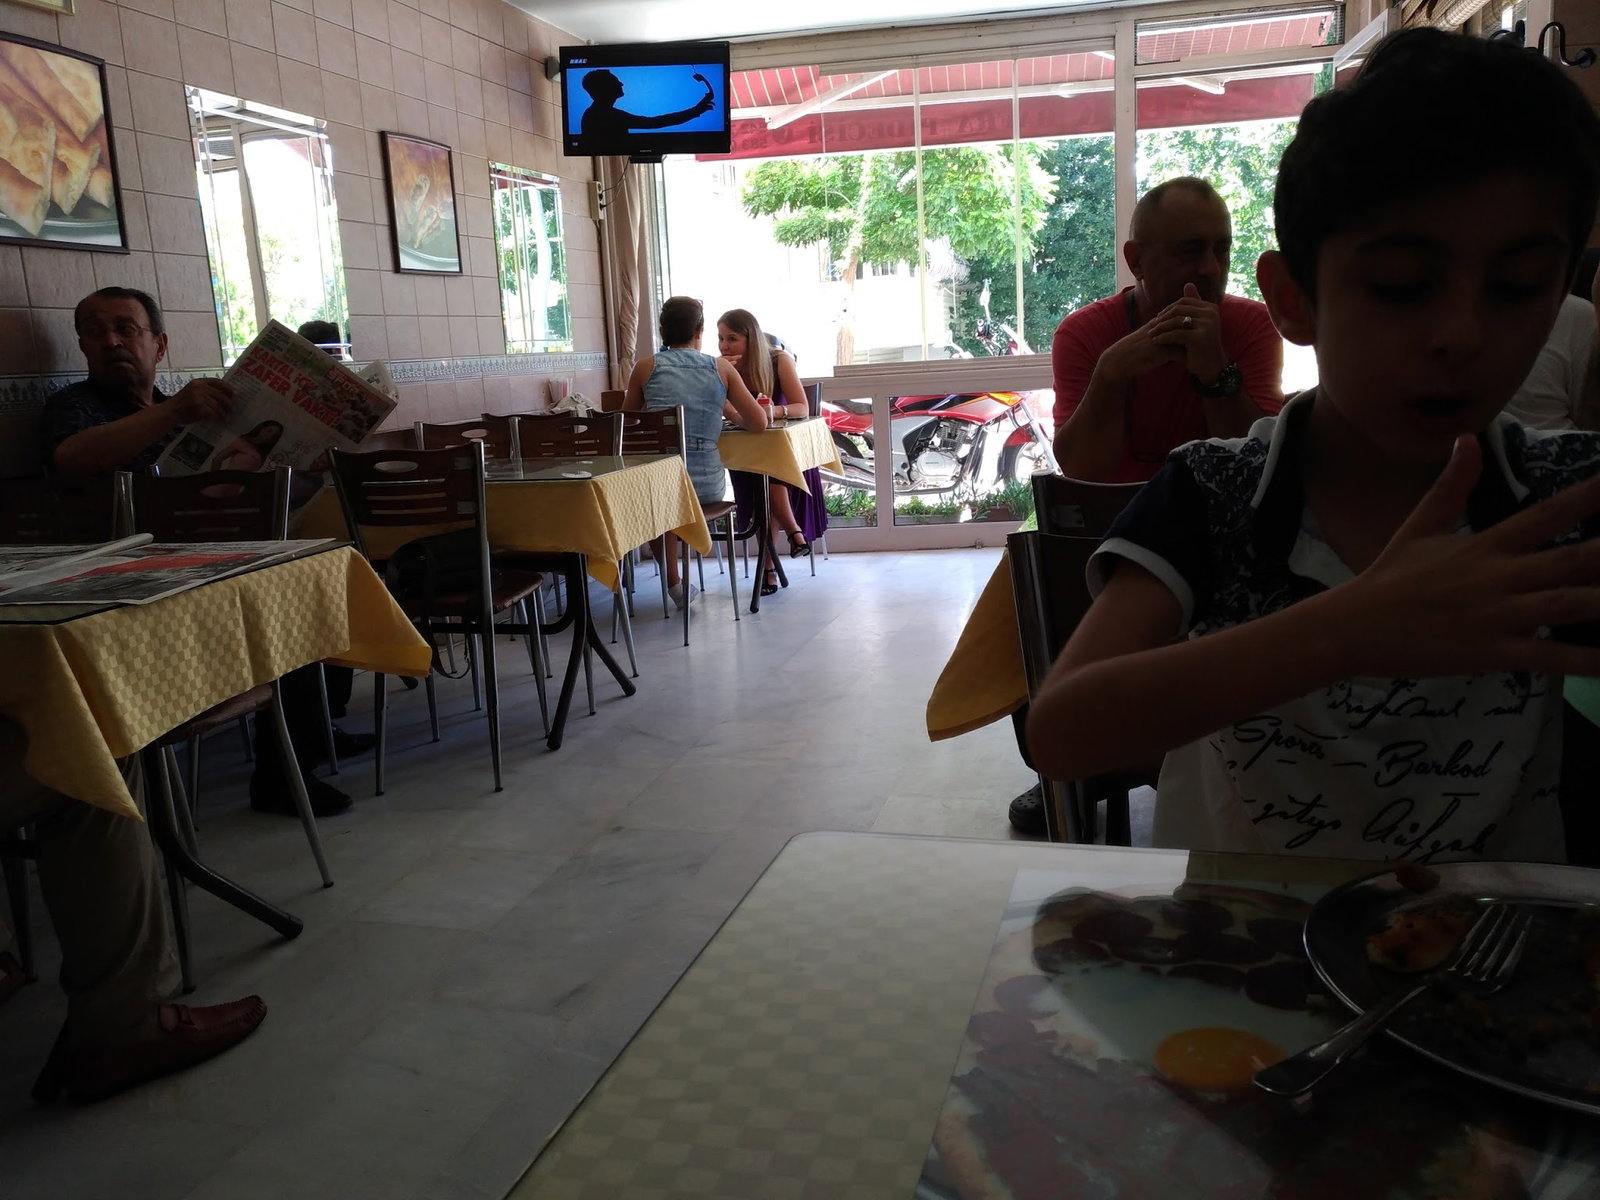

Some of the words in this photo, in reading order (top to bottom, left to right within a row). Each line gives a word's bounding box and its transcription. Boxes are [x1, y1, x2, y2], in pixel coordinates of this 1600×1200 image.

[240, 357, 291, 396] ZAFER
[250, 346, 293, 380] KARTAL
[1374, 739, 1504, 787] Barkod
